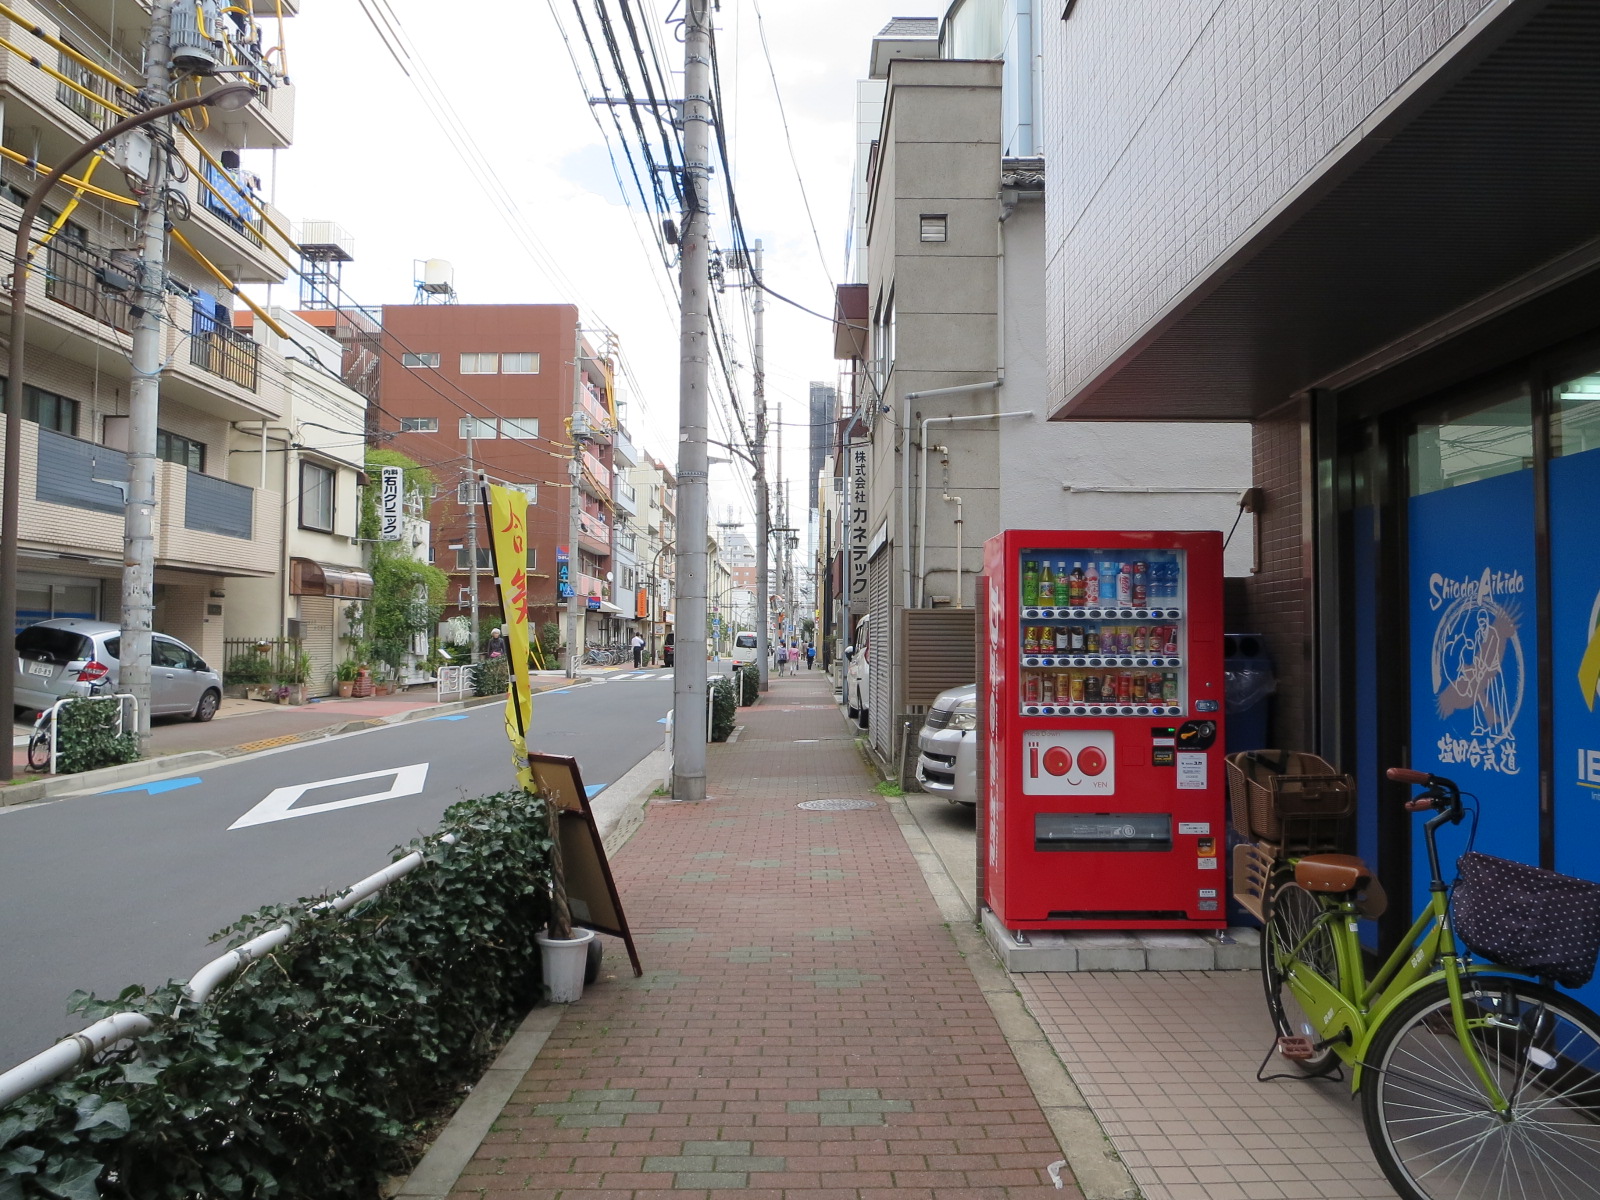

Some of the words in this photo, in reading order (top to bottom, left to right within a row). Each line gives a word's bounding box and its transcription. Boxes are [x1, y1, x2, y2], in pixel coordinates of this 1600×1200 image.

[384, 476, 397, 534] 石川クリニック
[1473, 567, 1525, 606] Aikido
